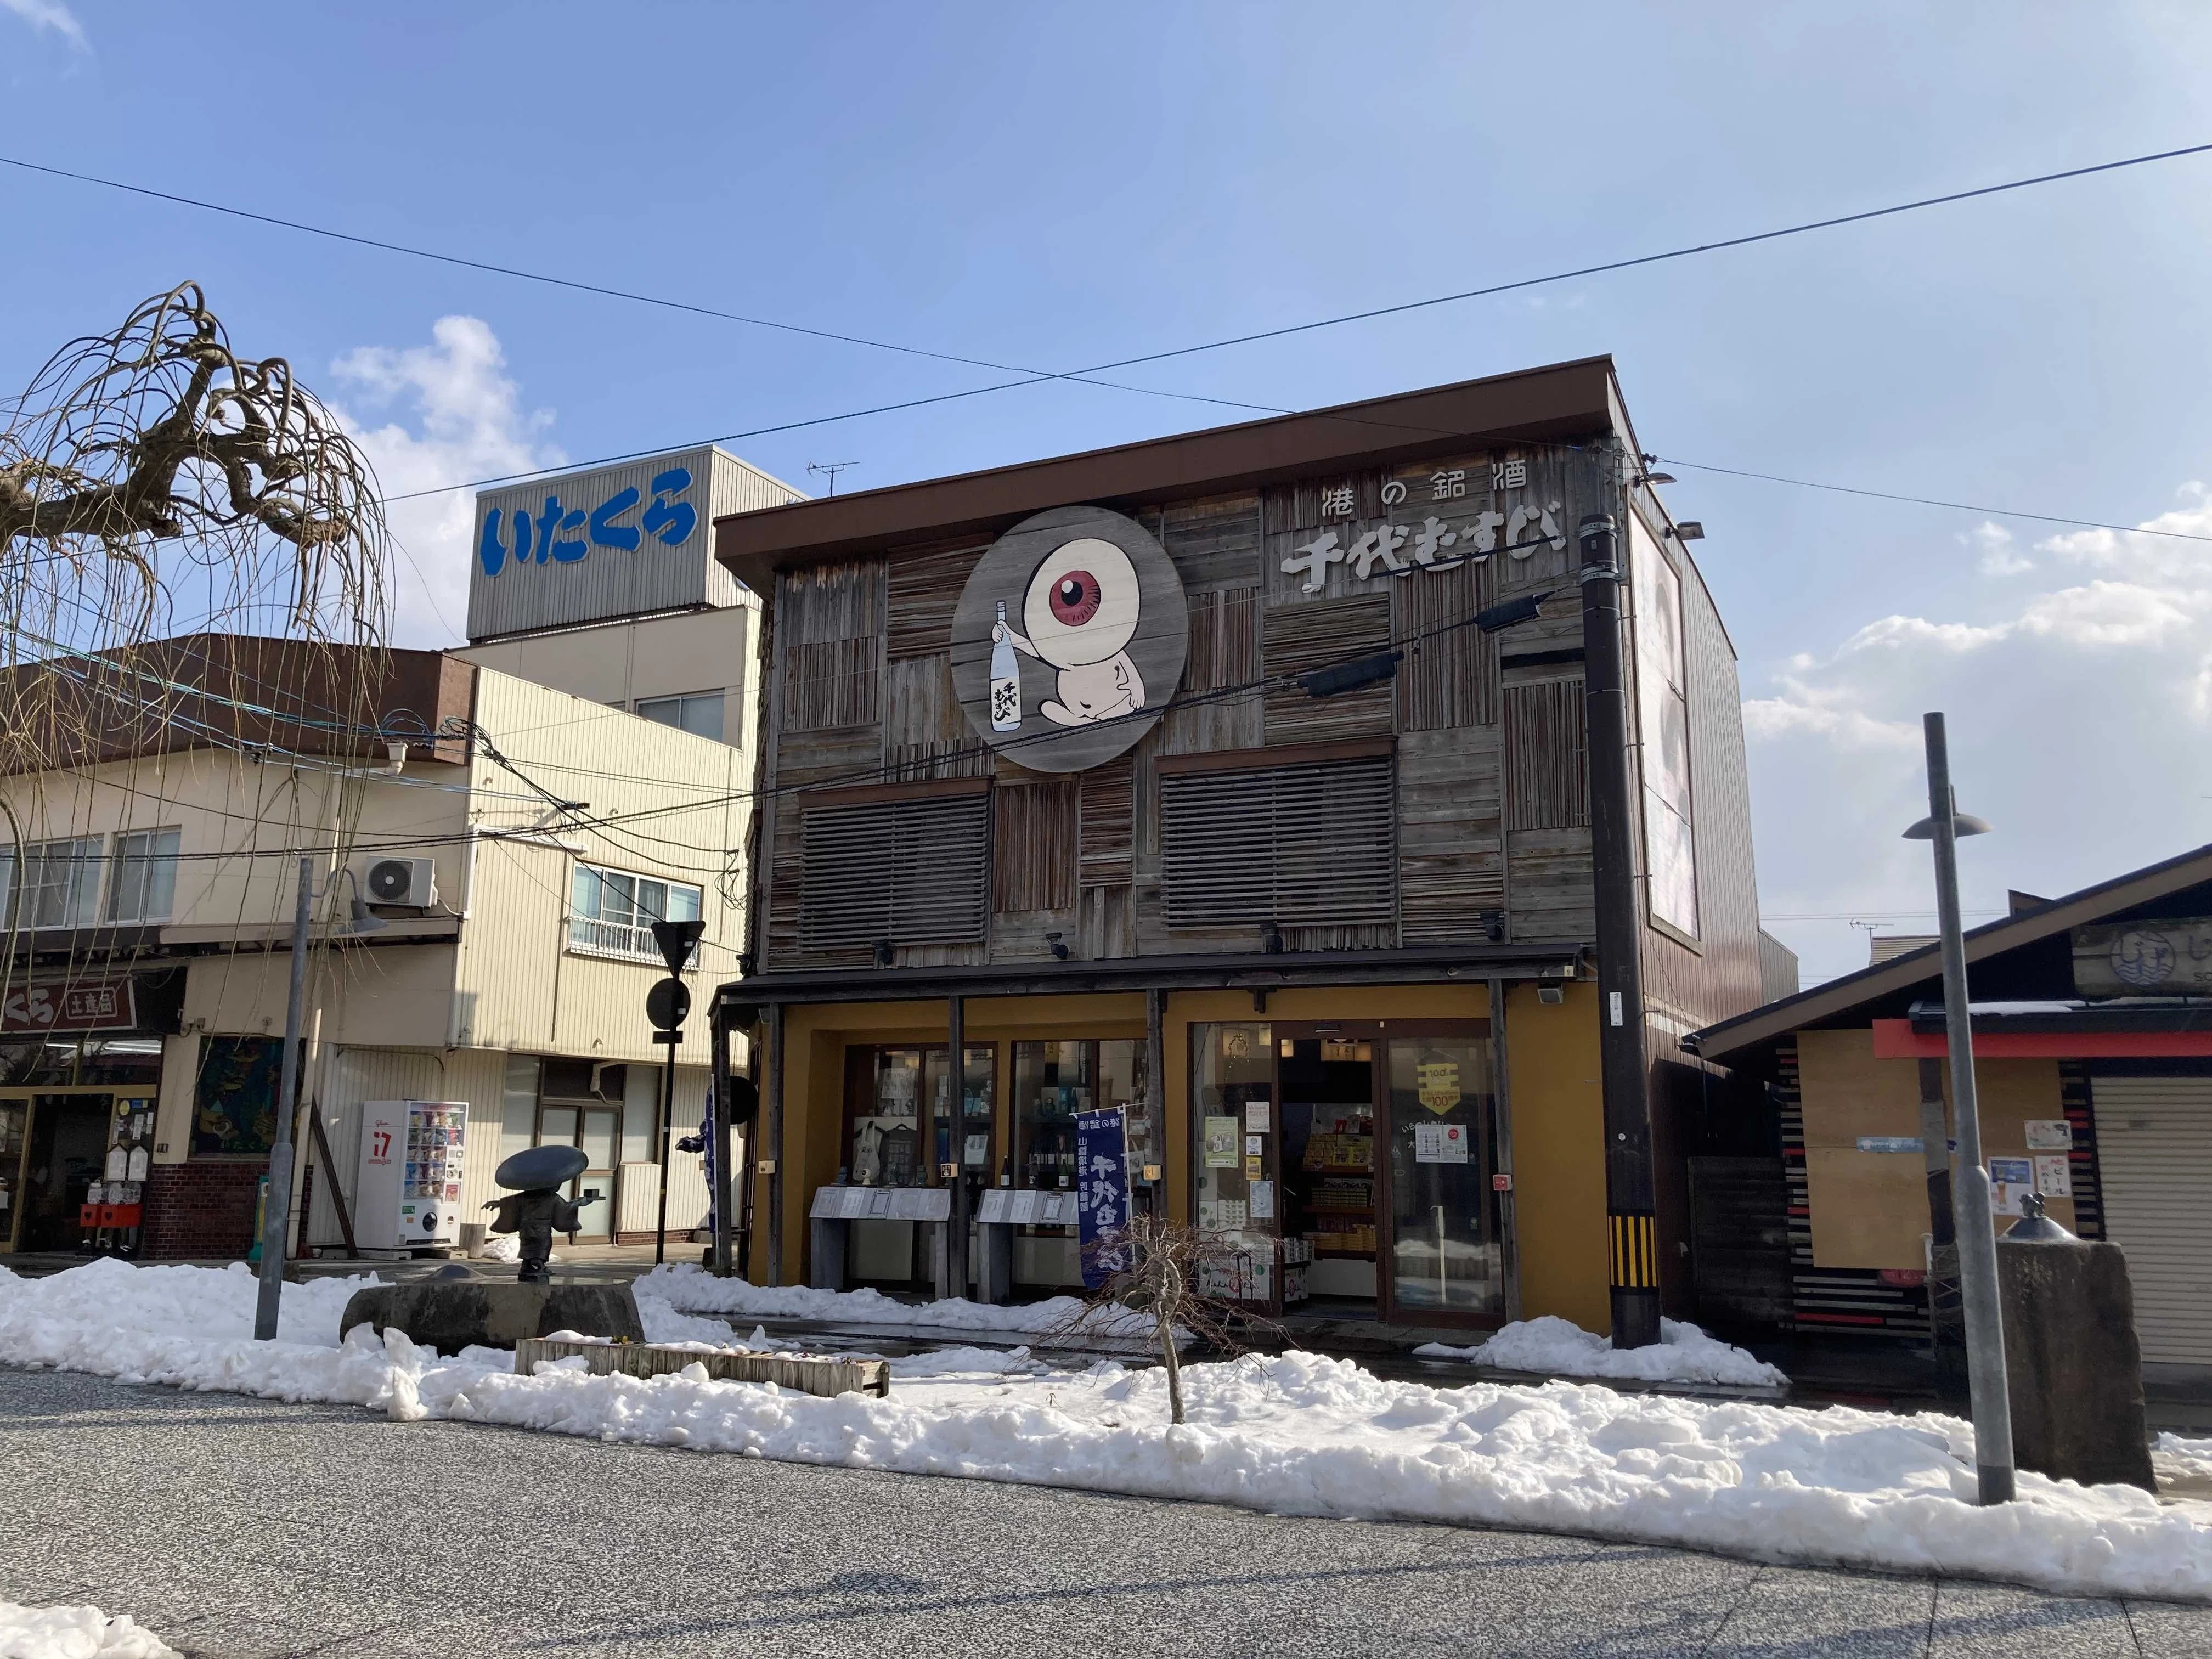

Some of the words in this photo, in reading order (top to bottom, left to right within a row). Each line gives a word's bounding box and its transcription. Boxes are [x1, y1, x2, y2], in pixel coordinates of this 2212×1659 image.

[1321, 460, 1527, 517] 港の銘酒
[480, 467, 698, 577] いたくら
[1280, 500, 1566, 594] 千代むすび
[994, 689, 1011, 721] むすび
[1002, 682, 1017, 707] 千代
